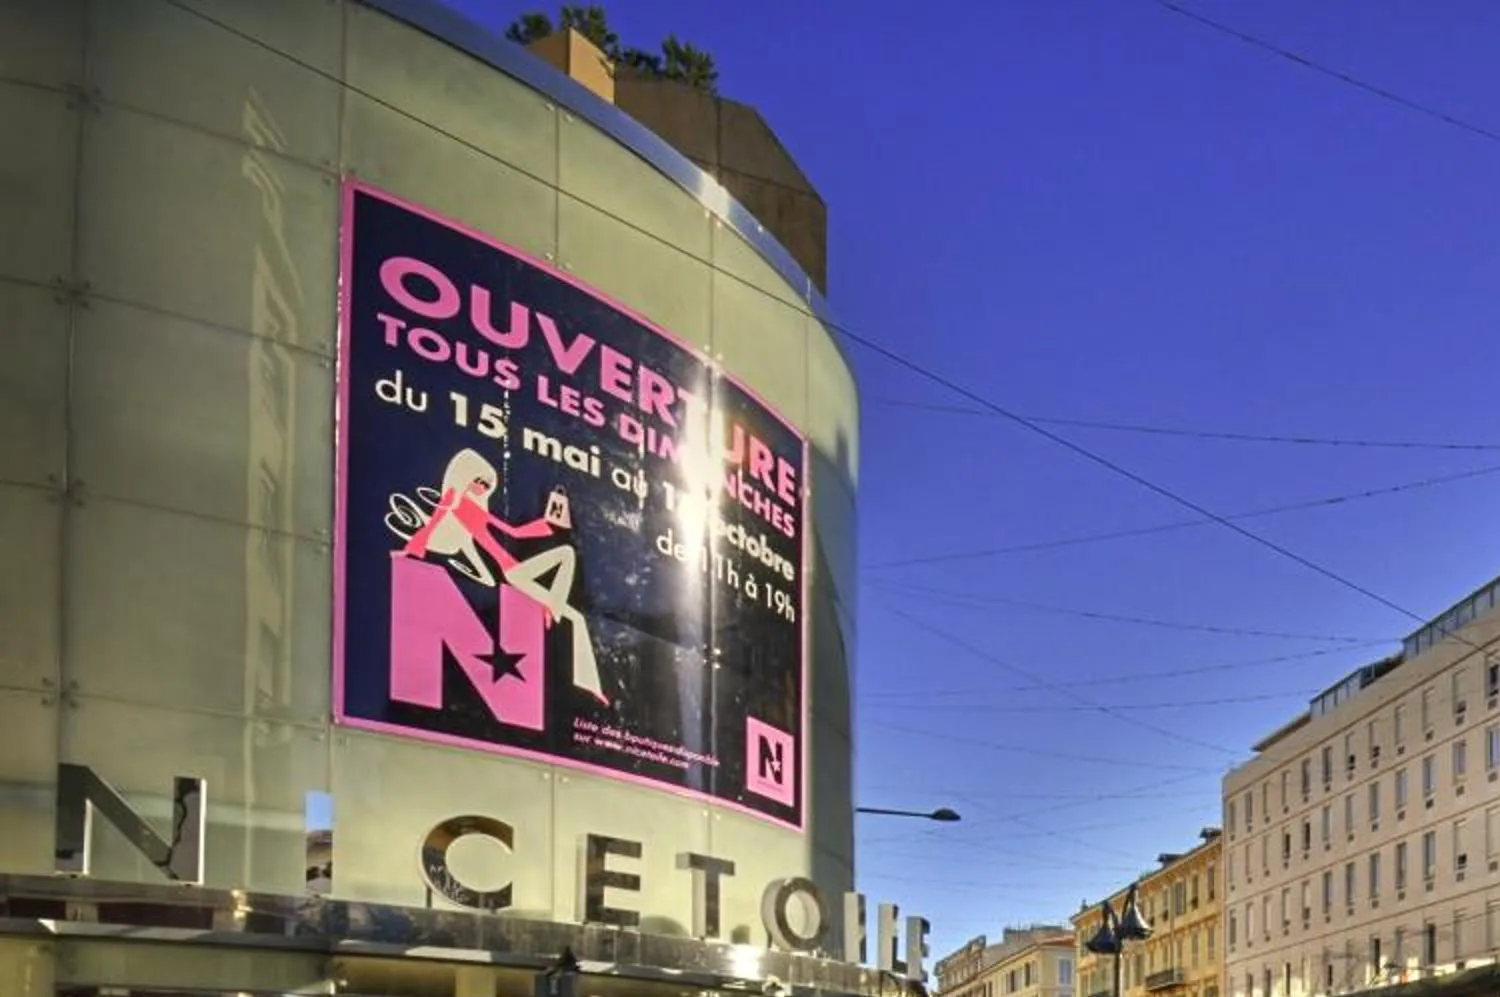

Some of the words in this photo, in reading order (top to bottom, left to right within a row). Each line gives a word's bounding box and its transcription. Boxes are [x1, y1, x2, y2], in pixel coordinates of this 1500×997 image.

[375, 370, 427, 412] du
[450, 391, 507, 439] 15
[523, 427, 601, 477] mai
[611, 467, 648, 499] au
[377, 313, 521, 390] TOUS
[537, 375, 606, 428] LES
[619, 412, 796, 539] DIMNCHES
[745, 574, 758, 600] à
[764, 583, 796, 624] 19h
[758, 733, 784, 786] N
